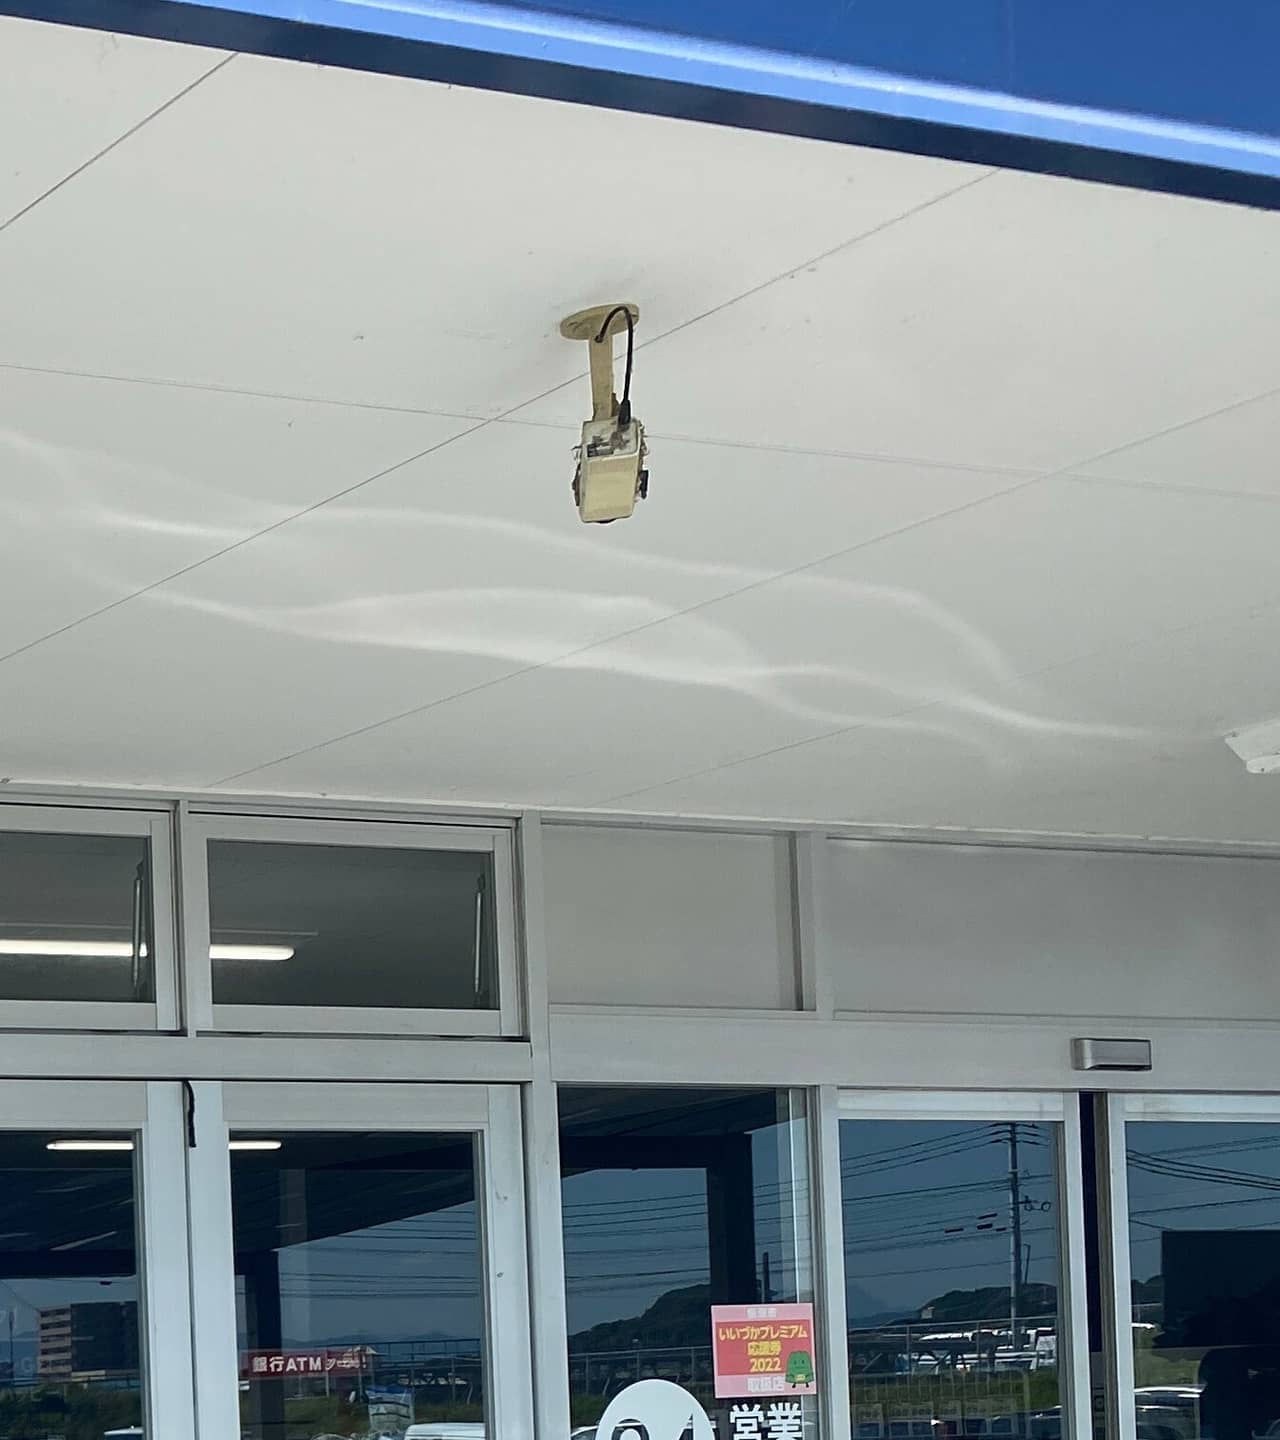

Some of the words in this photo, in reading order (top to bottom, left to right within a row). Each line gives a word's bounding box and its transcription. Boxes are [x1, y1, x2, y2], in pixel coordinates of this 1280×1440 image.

[718, 1324, 808, 1341] いいづかプレミアム
[252, 1355, 322, 1373] 銀行ATM
[750, 1358, 782, 1373] 2022
